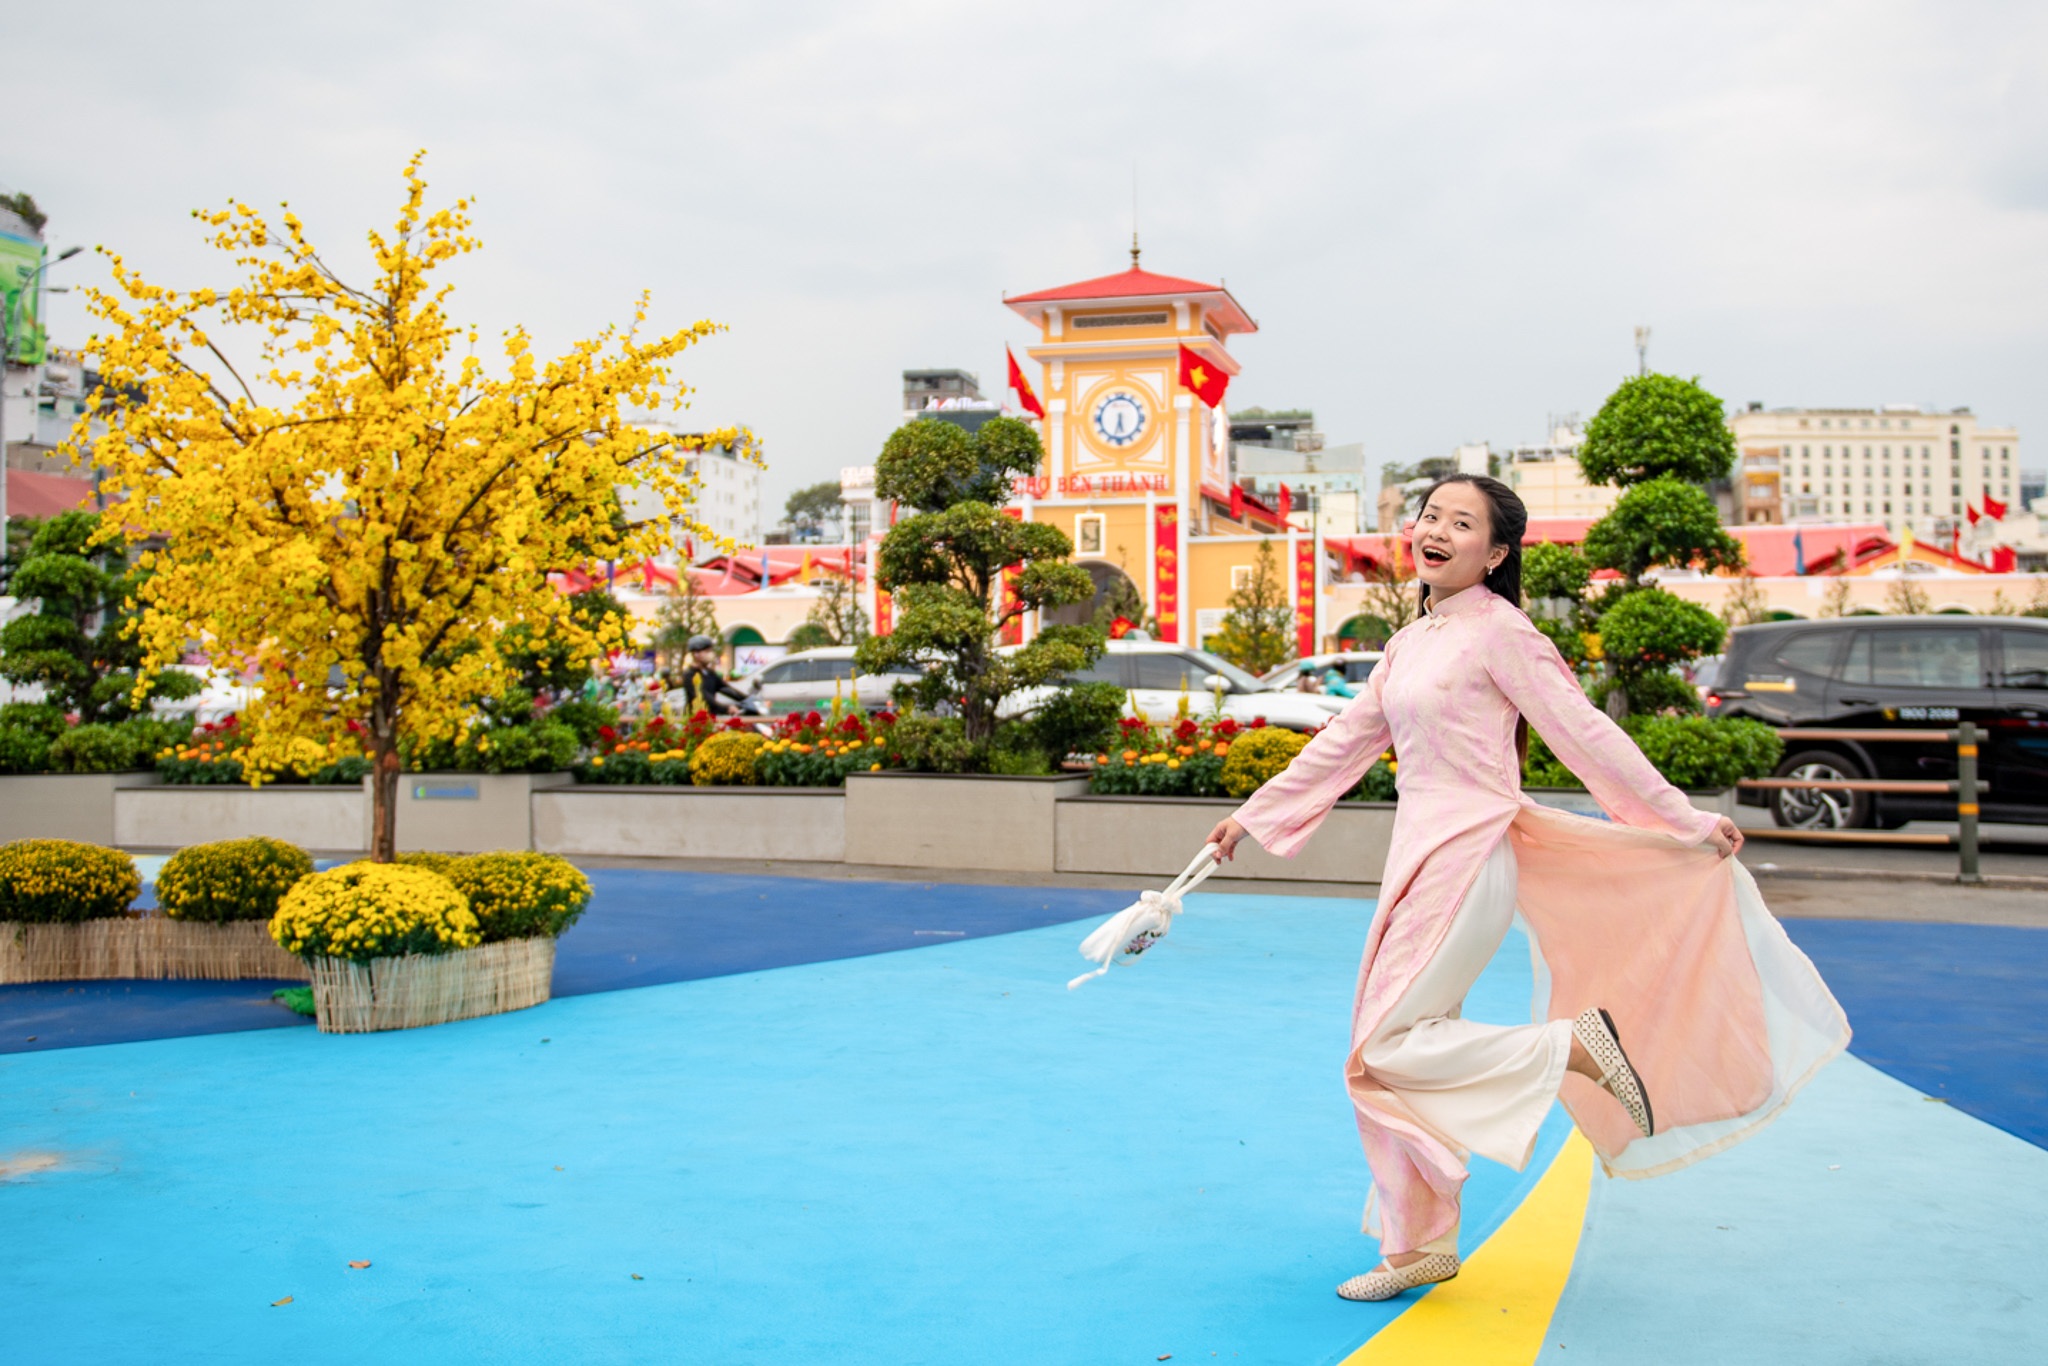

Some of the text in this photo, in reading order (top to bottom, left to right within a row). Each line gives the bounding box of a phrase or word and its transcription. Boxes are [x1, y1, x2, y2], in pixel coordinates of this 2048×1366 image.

[1012, 471, 1166, 499] CHỢ BẾN THÀNH
